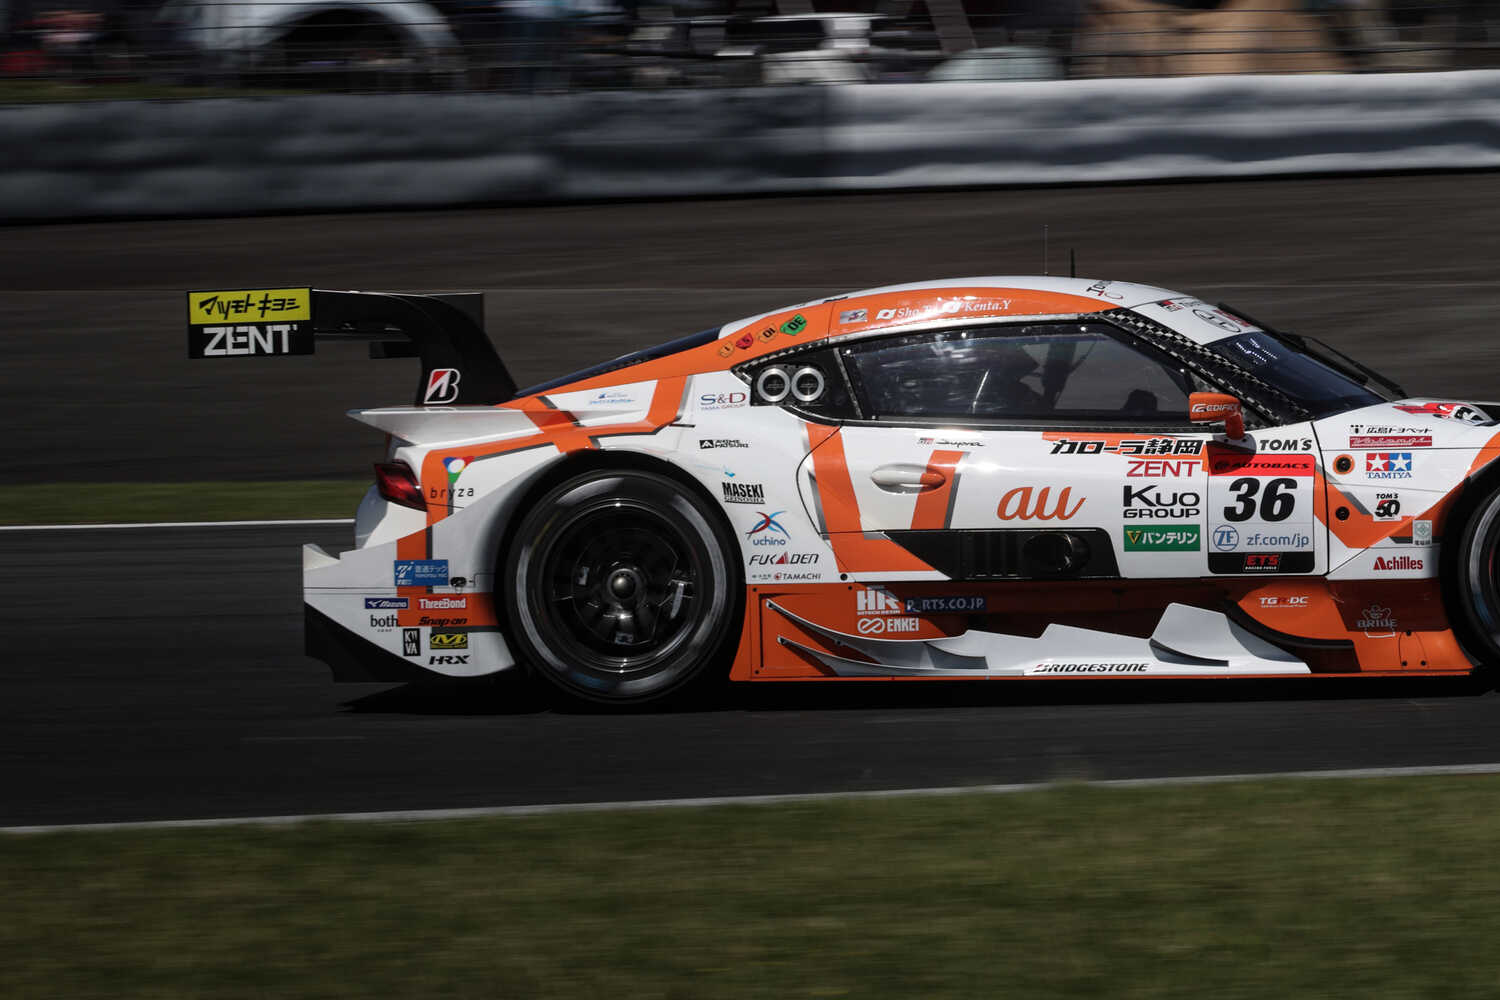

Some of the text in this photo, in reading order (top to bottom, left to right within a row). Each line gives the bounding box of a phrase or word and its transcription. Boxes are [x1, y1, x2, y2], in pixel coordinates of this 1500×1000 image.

[203, 324, 298, 356] ZENT
[700, 392, 747, 406] S&D
[1050, 438, 1204, 456] カローラ静岡
[1259, 437, 1313, 451] TOM'S
[1126, 461, 1201, 477] ZENT
[1367, 471, 1412, 480] TAMIYA
[430, 487, 475, 499] bryza
[722, 481, 764, 498] MASEKI
[997, 486, 1087, 521] au
[1223, 477, 1298, 522] 36
[1123, 508, 1200, 518] GROUP
[1374, 499, 1401, 518] 50
[752, 536, 786, 546] uchino
[1246, 533, 1310, 547] zf.com/jp
[1373, 556, 1424, 571] Achilles
[782, 573, 822, 581] TAMACHI
[418, 598, 467, 609] ThreeBond
[887, 618, 919, 632] ENKEI
[429, 655, 470, 665] HRX
[1034, 663, 1149, 673] BRIDGESTONE
